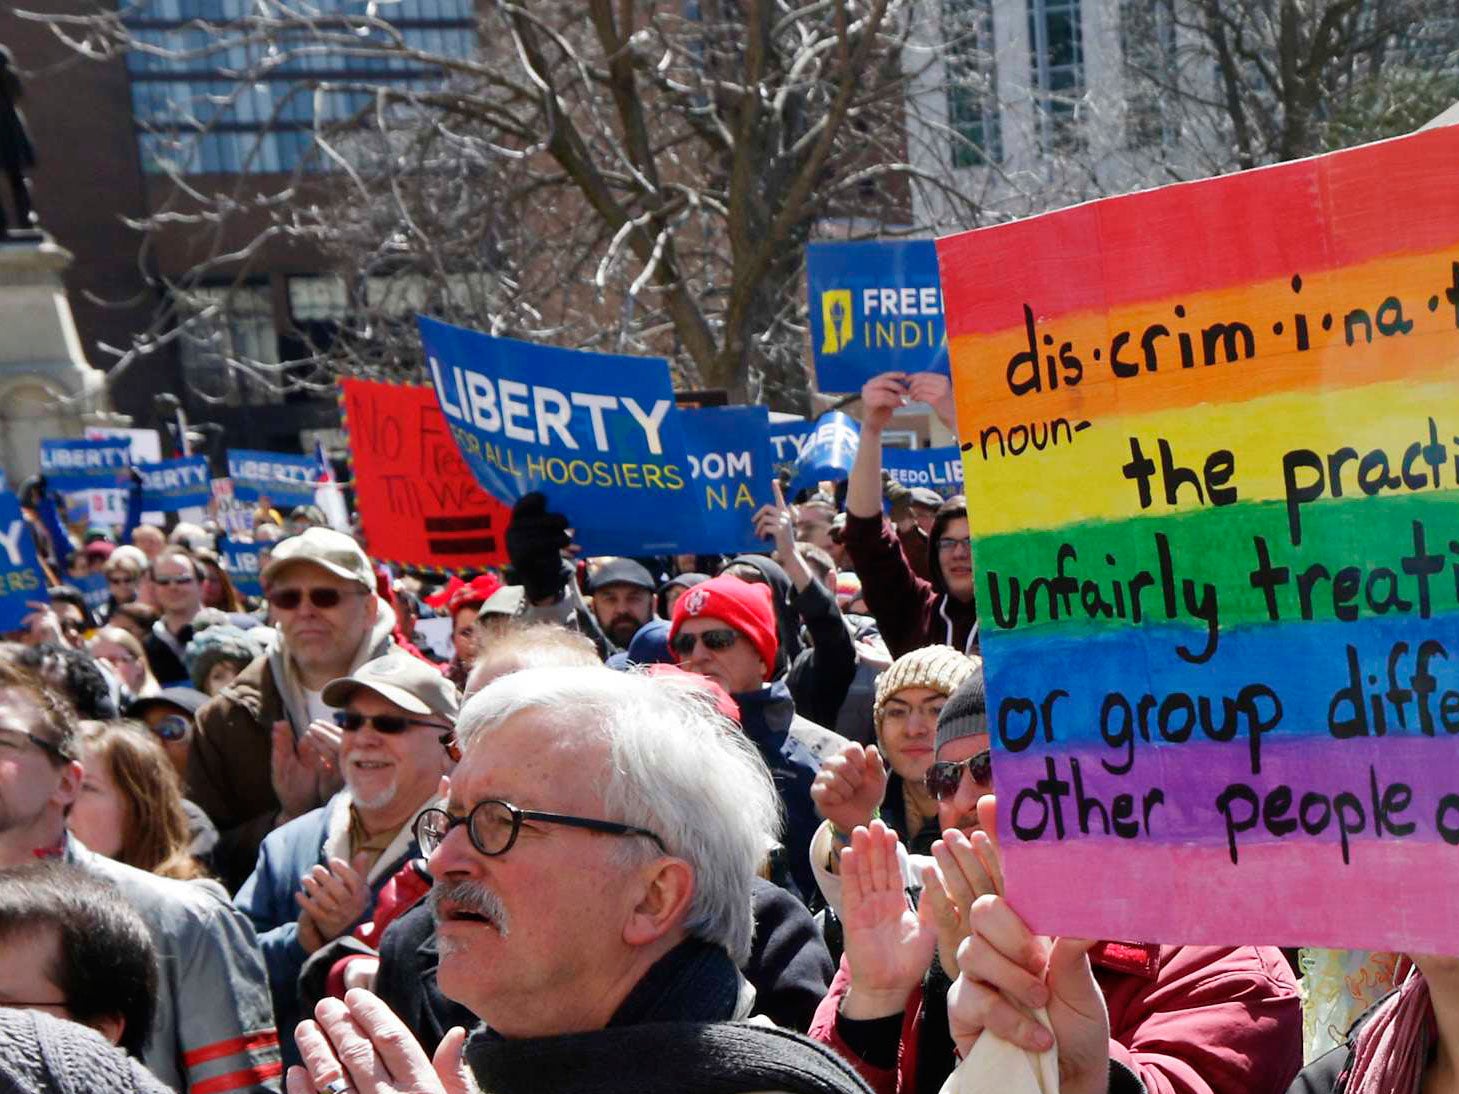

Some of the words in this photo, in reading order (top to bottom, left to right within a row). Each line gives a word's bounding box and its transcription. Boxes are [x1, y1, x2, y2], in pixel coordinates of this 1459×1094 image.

[429, 357, 672, 455] LIBERTY
[41, 448, 130, 471] LIBERTY
[229, 459, 315, 482] LIBERTY
[485, 444, 523, 478] ALL
[527, 453, 685, 490] HOOSIERS
[1122, 437, 1238, 508] the
[987, 533, 1219, 664] unfairly
[998, 689, 1069, 752] or
[1101, 683, 1283, 774] group
[1011, 757, 1165, 841] other
[1216, 764, 1416, 865] people
